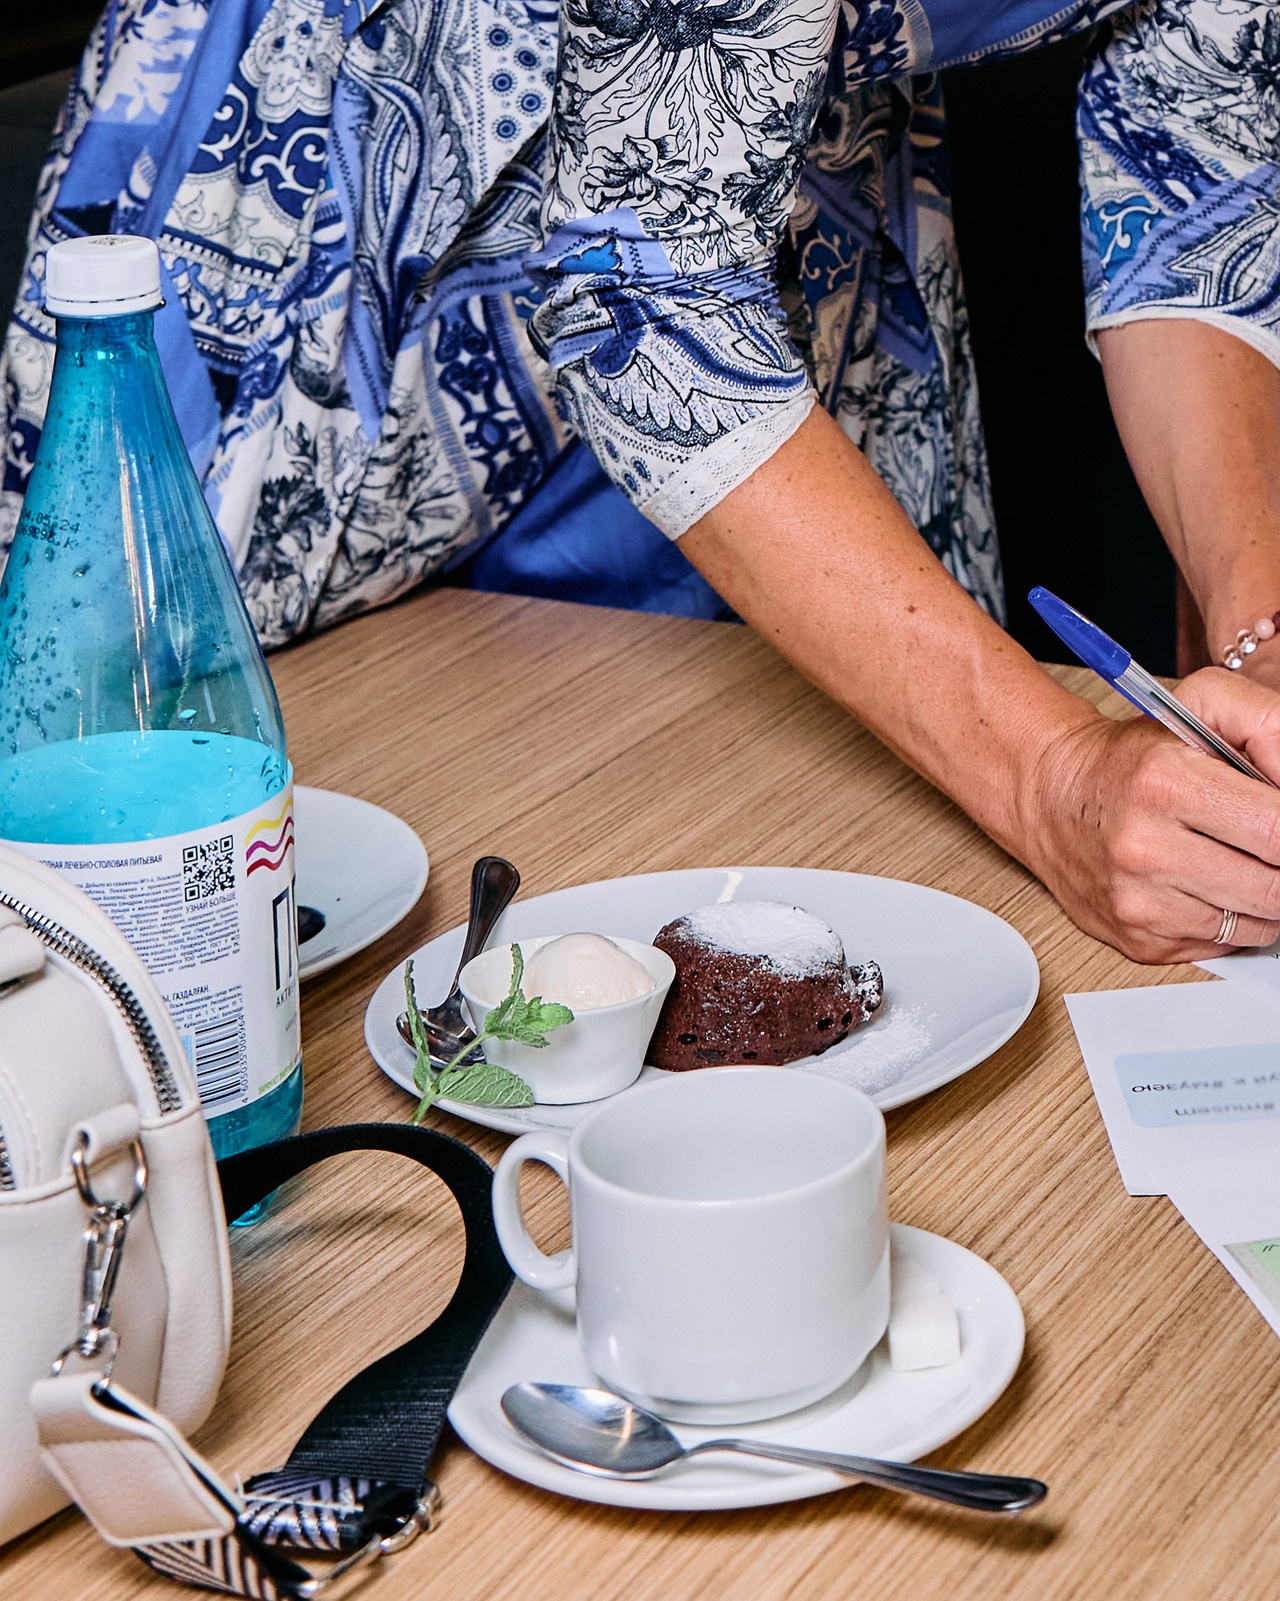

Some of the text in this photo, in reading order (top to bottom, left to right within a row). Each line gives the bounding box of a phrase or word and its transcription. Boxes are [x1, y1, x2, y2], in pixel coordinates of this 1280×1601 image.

[185, 891, 237, 914] УЗНАЙ БОЛЬШЕ
[1131, 1080, 1223, 1093] #музею
[1174, 1101, 1275, 1116] #musem
